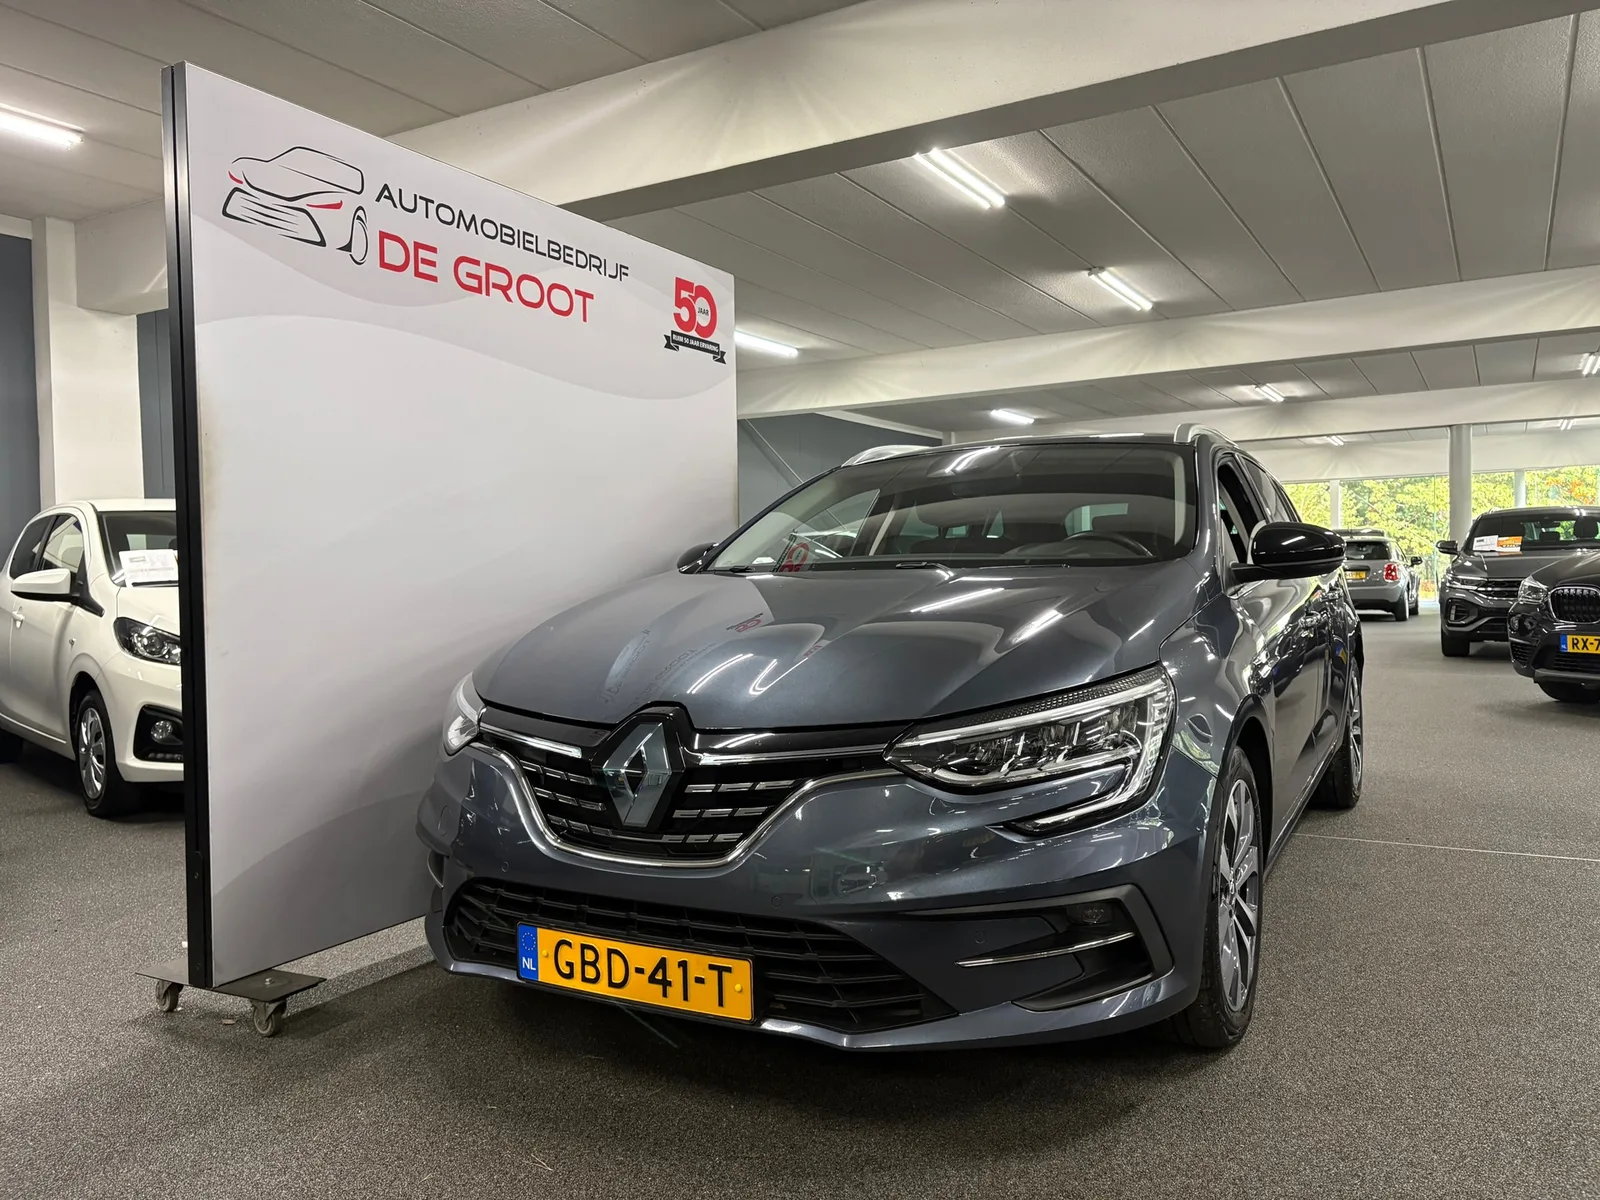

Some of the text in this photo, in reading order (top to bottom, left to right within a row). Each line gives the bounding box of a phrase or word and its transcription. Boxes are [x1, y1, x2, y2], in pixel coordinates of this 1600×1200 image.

[375, 182, 630, 282] AUTOMOBIELBEDRIJF
[379, 230, 595, 323] DE GROOT
[673, 276, 718, 339] 50
[697, 307, 710, 316] JAAR
[689, 339, 700, 347] JAAR
[699, 341, 719, 353] ERVARING
[522, 956, 536, 971] NL
[553, 939, 732, 1008] GBD-41-T
